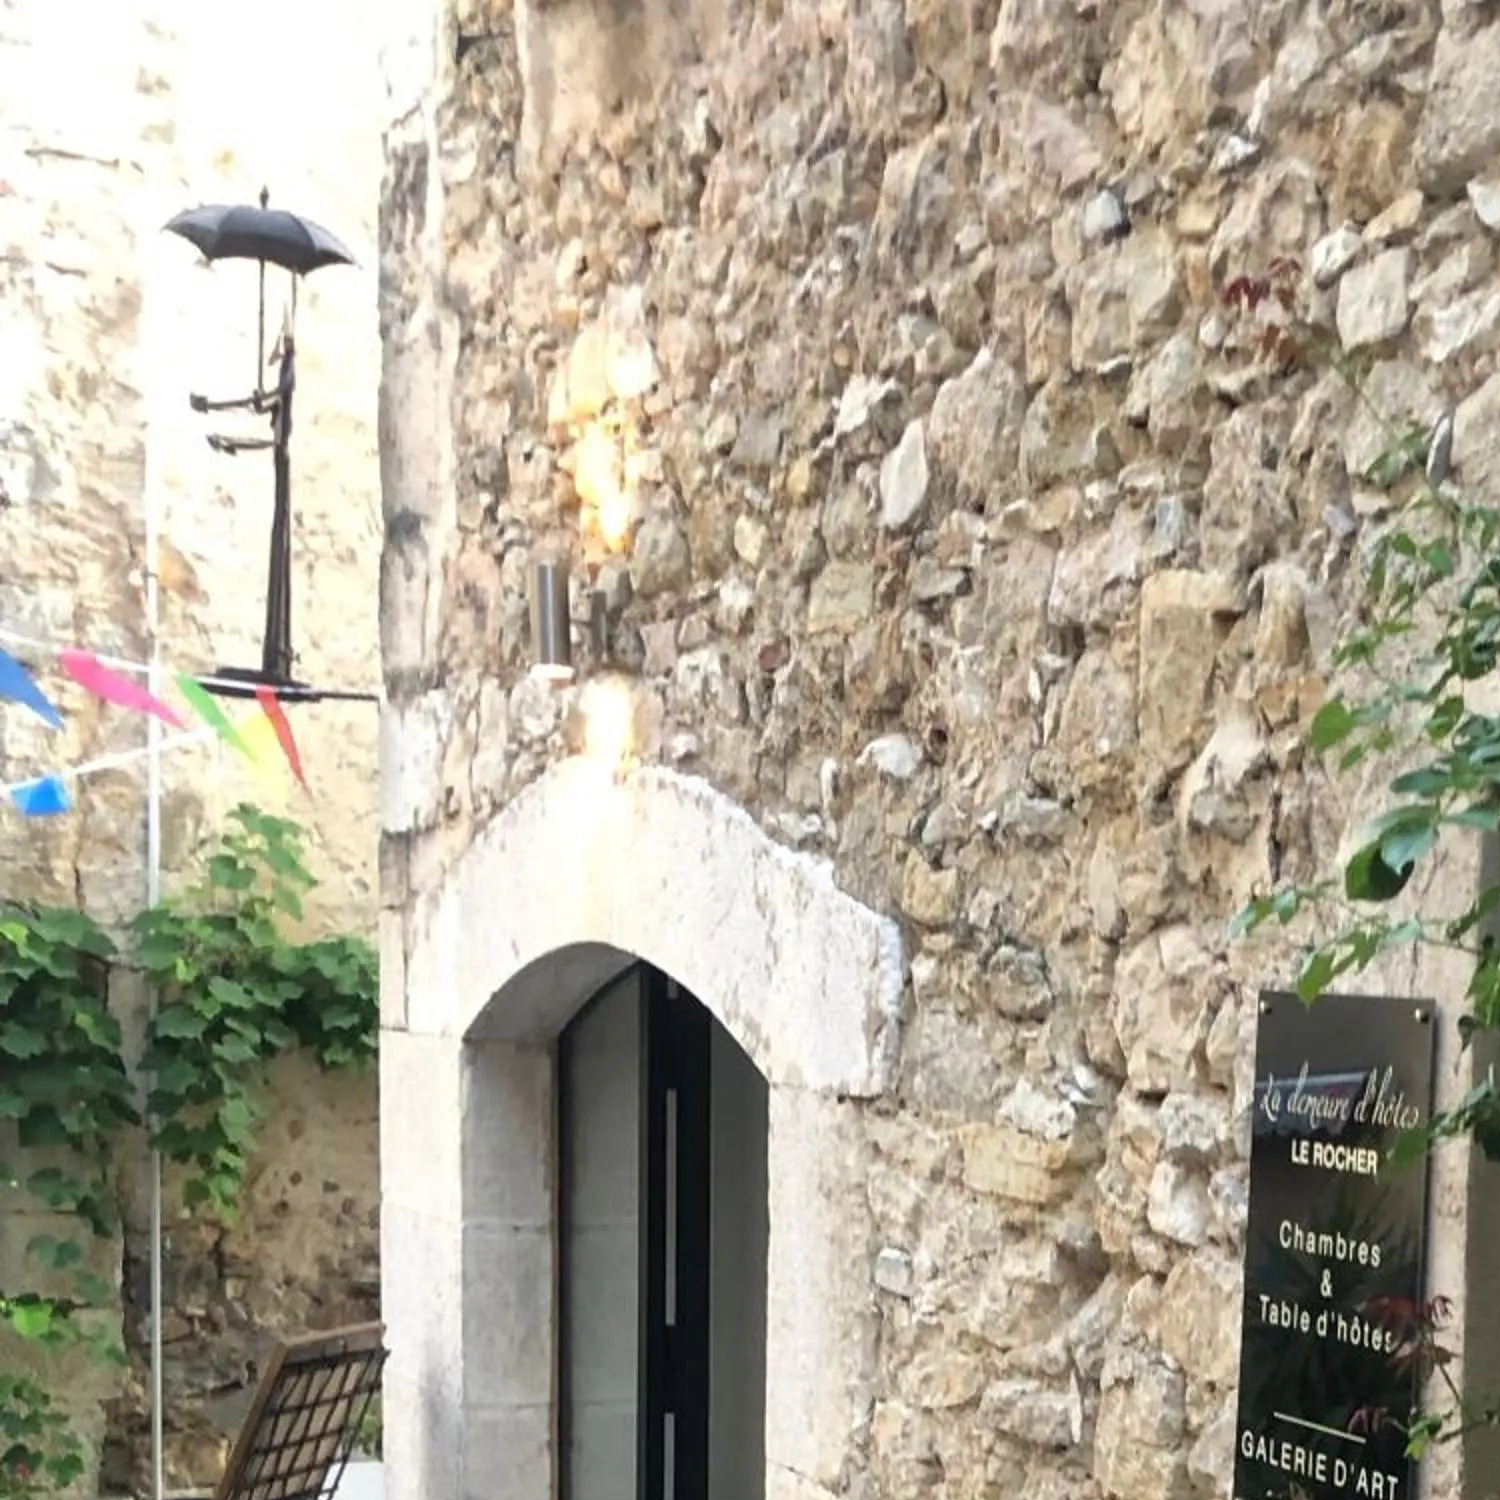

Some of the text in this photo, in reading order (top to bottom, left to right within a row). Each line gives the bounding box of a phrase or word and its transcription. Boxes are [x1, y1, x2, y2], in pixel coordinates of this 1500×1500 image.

[1287, 1060, 1350, 1130] demeure
[1291, 1139, 1377, 1175] LE ROCHER
[1279, 1219, 1381, 1268] Chambres
[1320, 1268, 1333, 1298] &
[1259, 1294, 1399, 1354] Table d'hôtes
[1241, 1430, 1327, 1482] GALERIE
